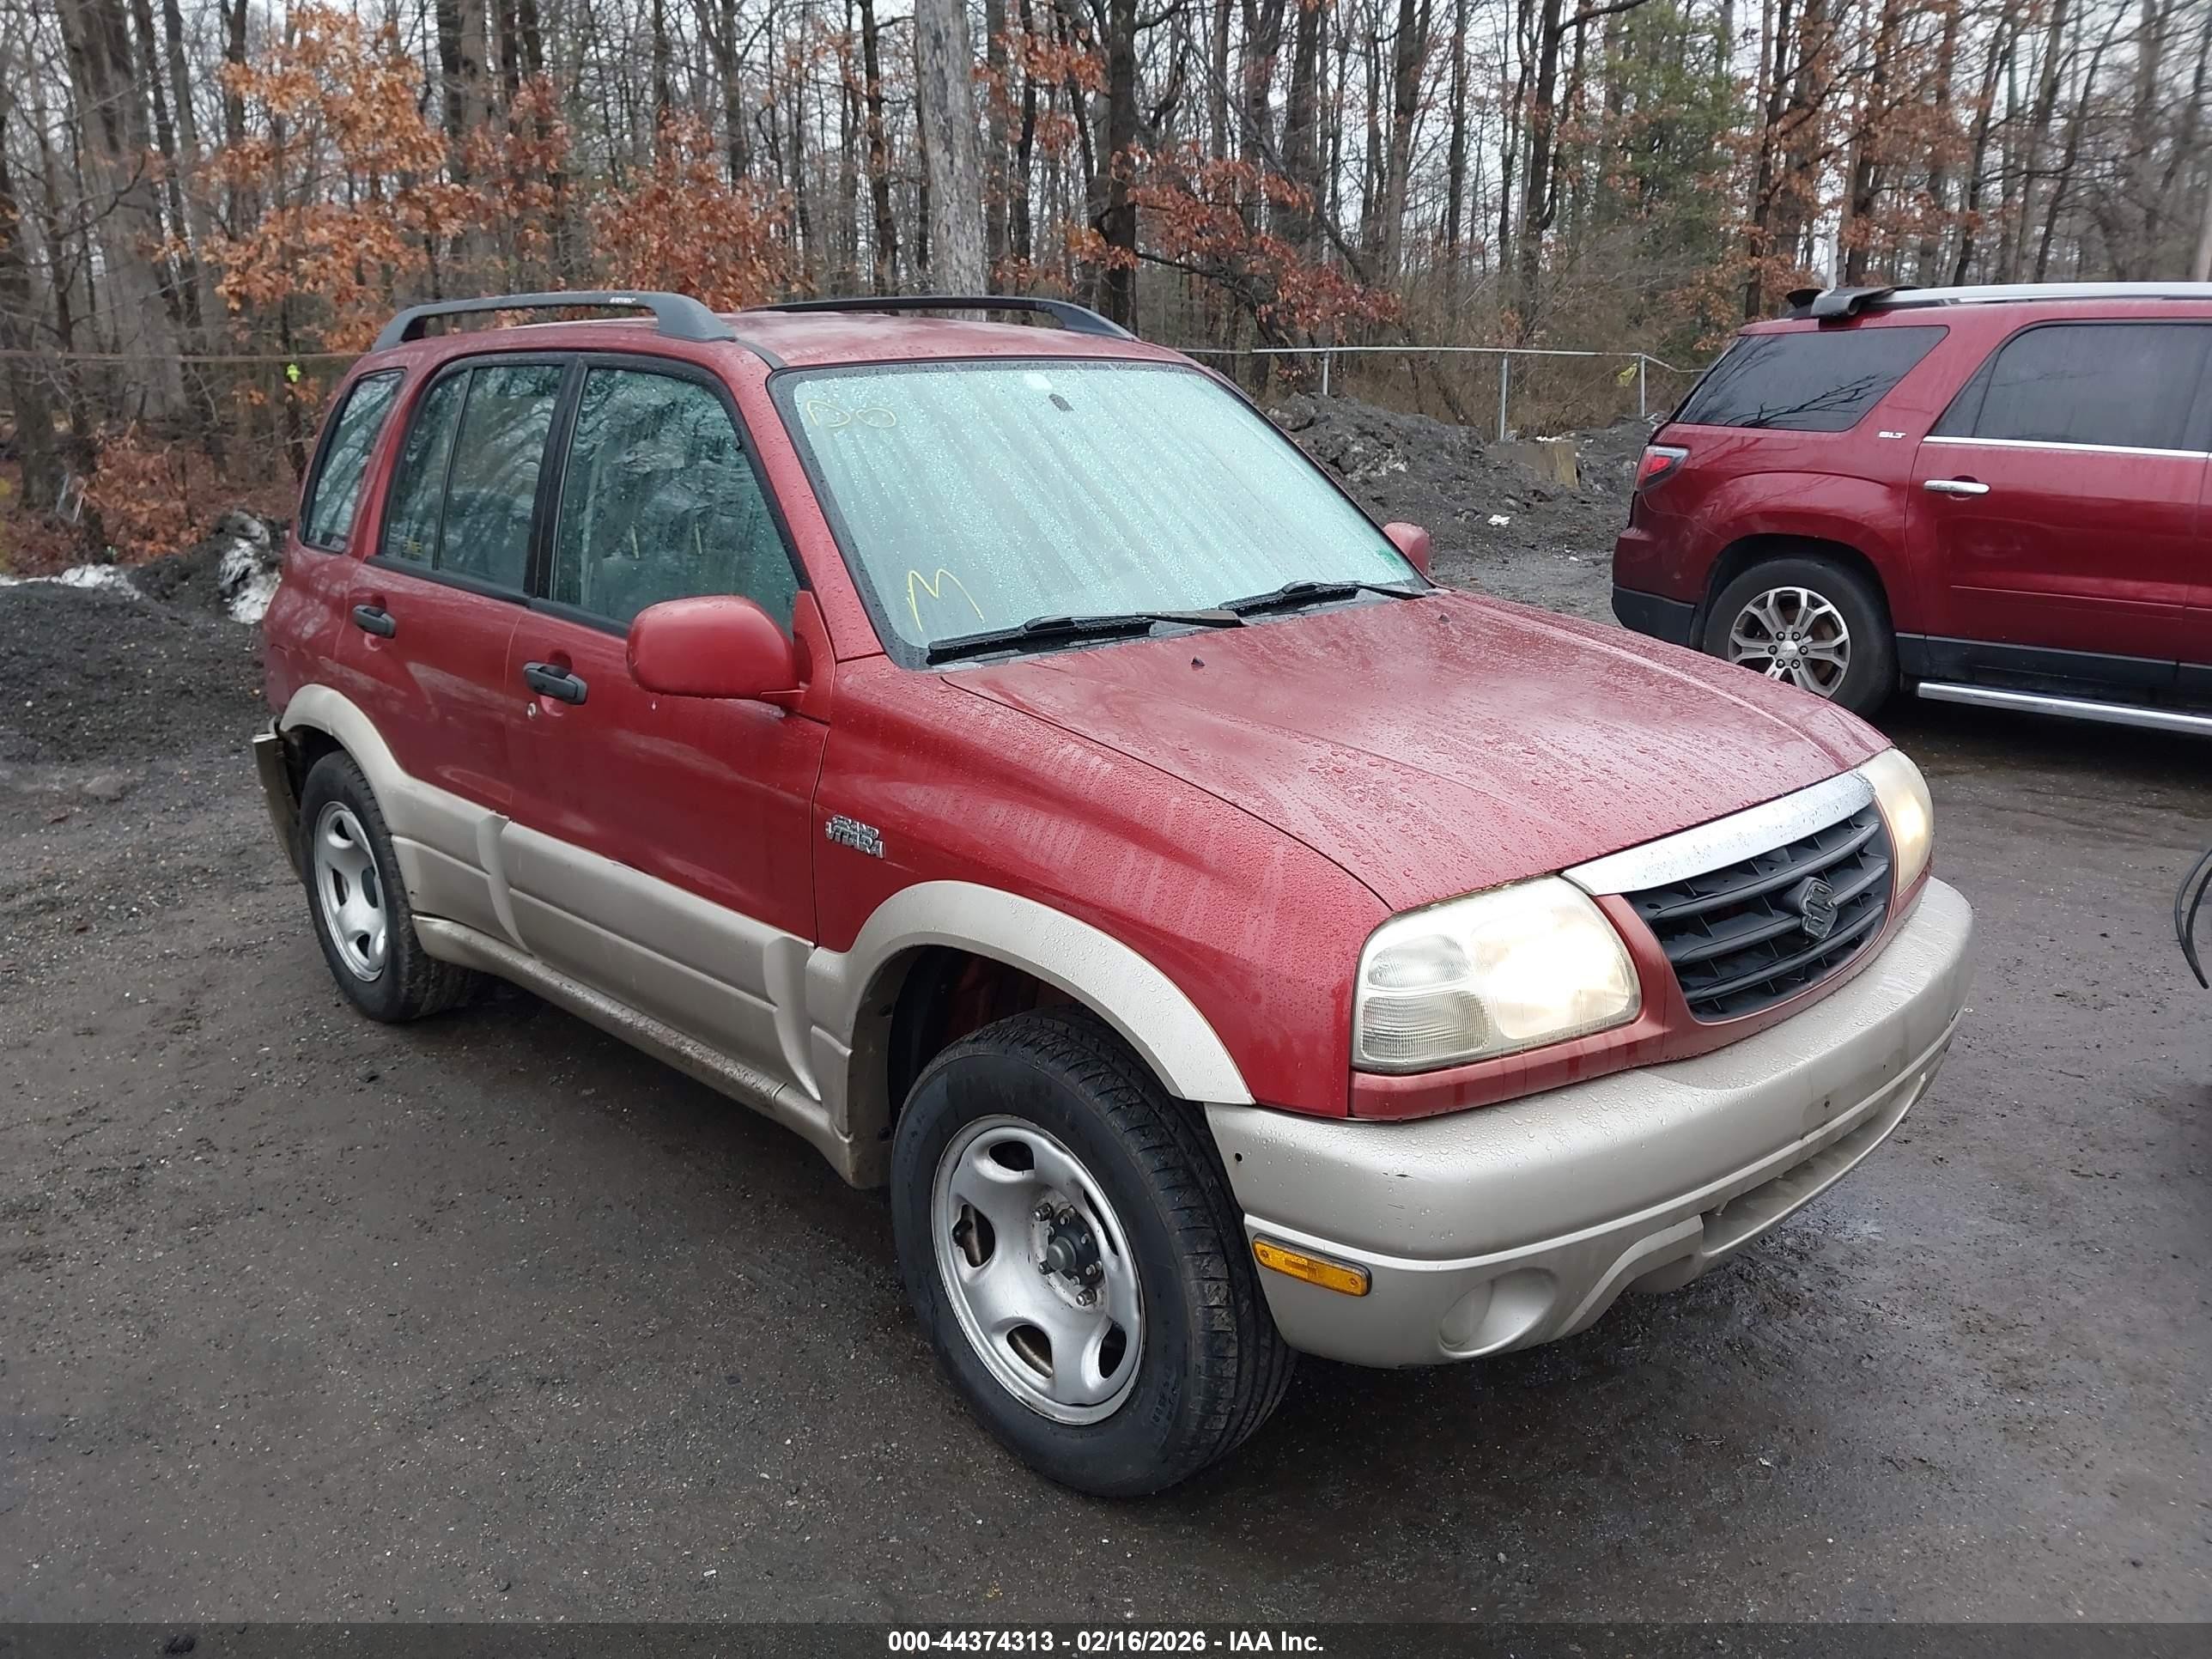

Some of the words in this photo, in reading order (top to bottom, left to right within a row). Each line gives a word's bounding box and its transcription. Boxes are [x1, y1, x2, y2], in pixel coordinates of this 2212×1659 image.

[1878, 431, 1907, 440] SLT
[907, 568, 986, 633] M
[824, 821, 884, 860] VITARA
[831, 814, 879, 840] GRAND
